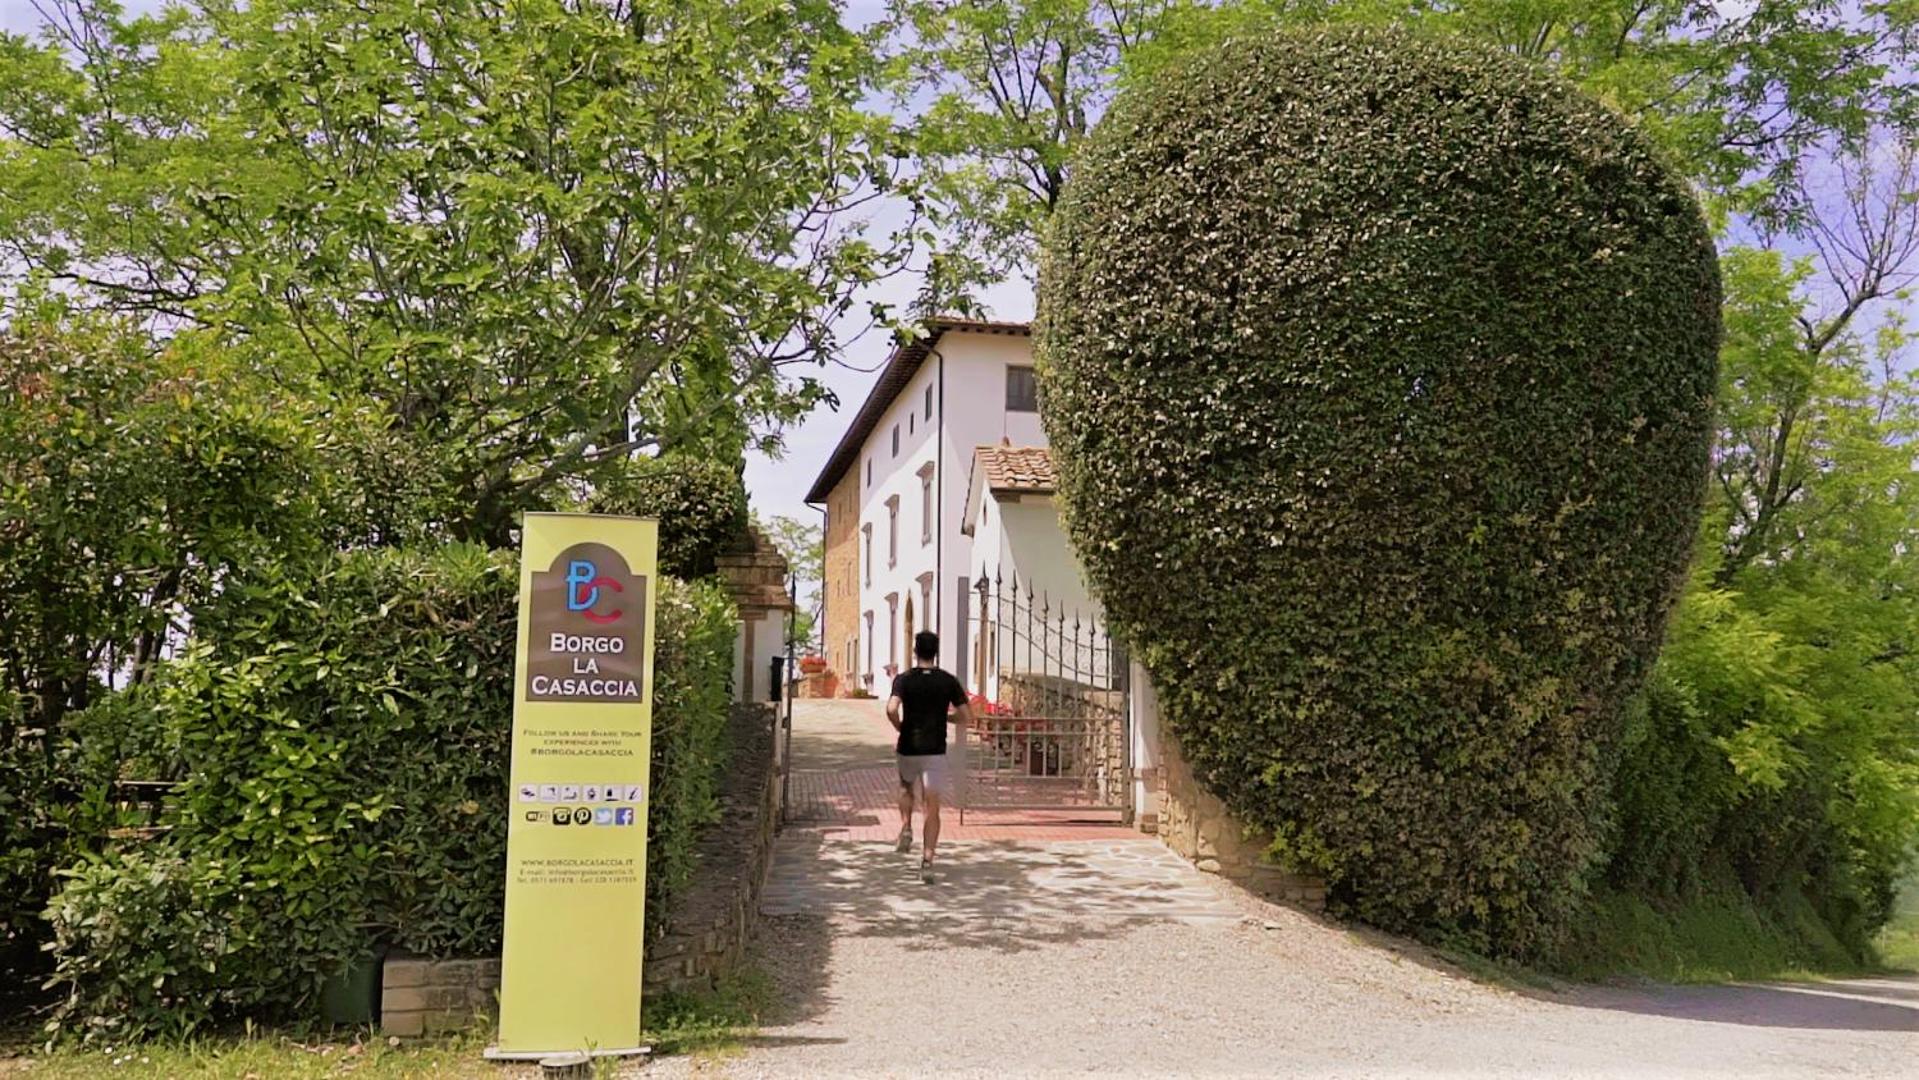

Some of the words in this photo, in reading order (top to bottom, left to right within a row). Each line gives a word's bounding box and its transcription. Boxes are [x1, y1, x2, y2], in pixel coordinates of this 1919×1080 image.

[550, 633, 624, 654] BORGO
[573, 658, 599, 674] LA
[531, 676, 639, 697] CASACCIA
